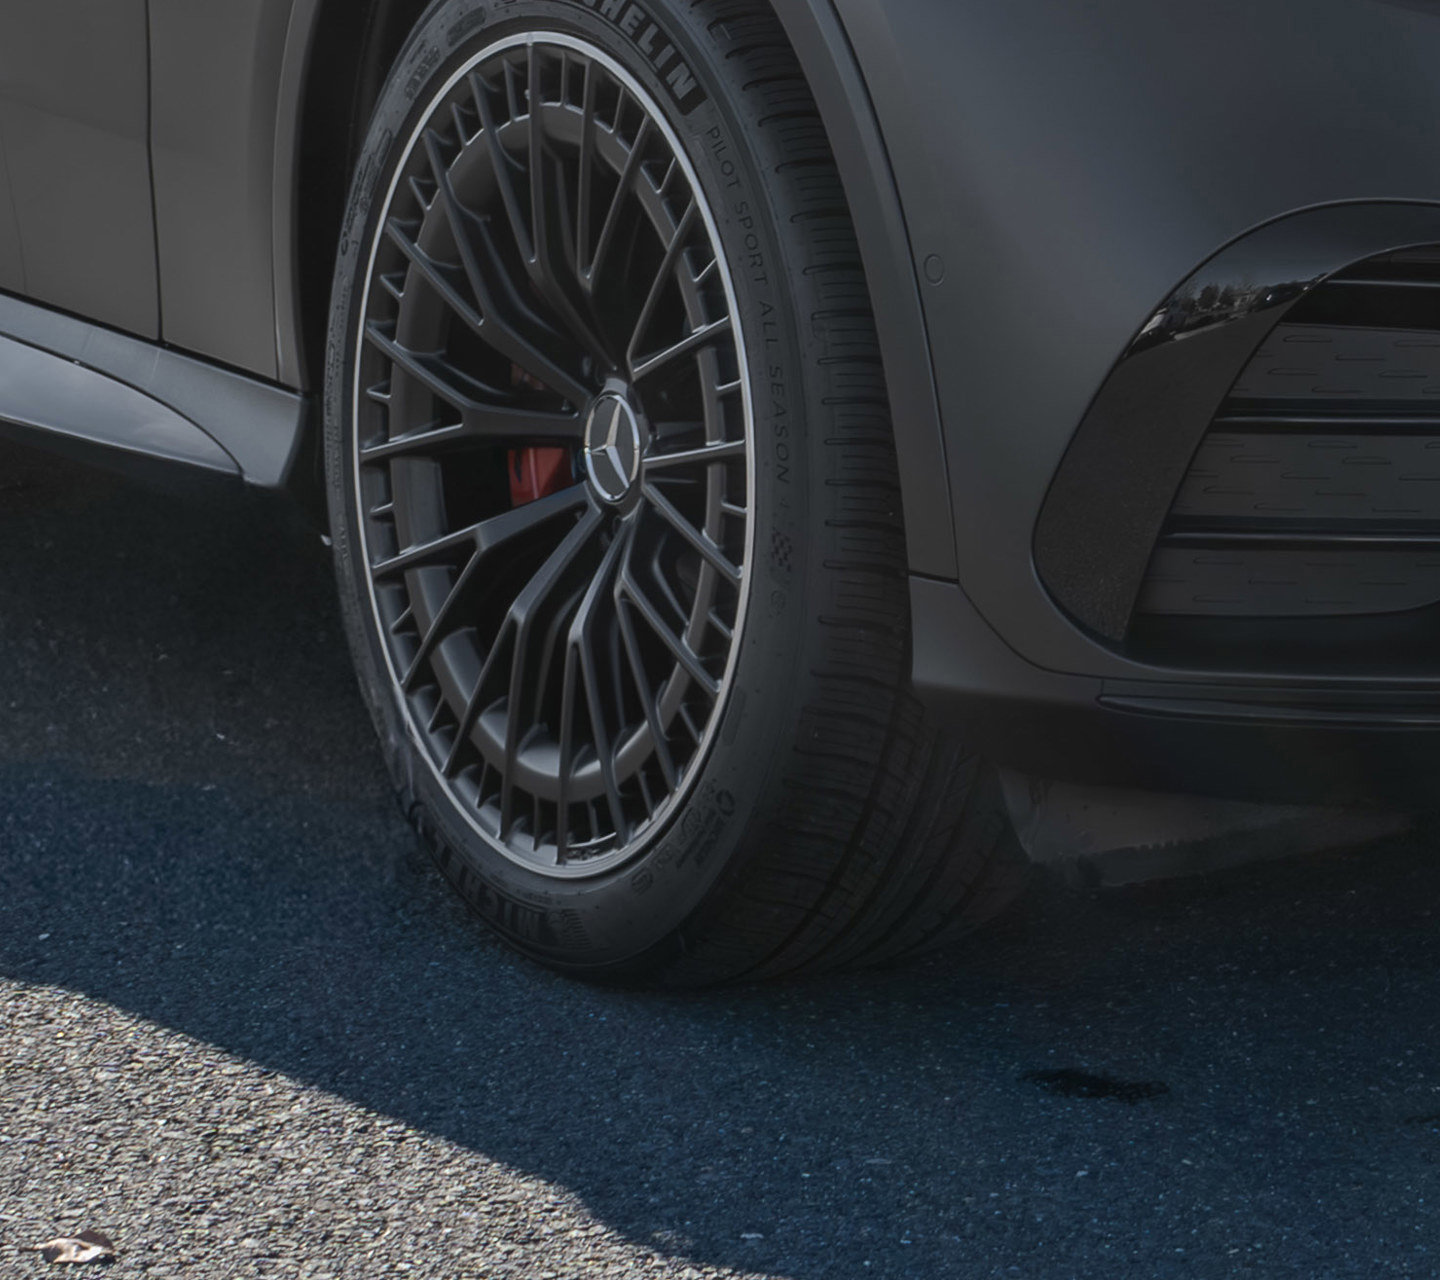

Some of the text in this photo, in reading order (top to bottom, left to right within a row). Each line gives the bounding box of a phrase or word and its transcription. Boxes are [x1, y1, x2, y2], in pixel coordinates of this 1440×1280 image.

[705, 125, 742, 188] PILOT
[733, 201, 769, 285] SPORT
[759, 300, 778, 345] ALL
[769, 366, 791, 484] SEASON
